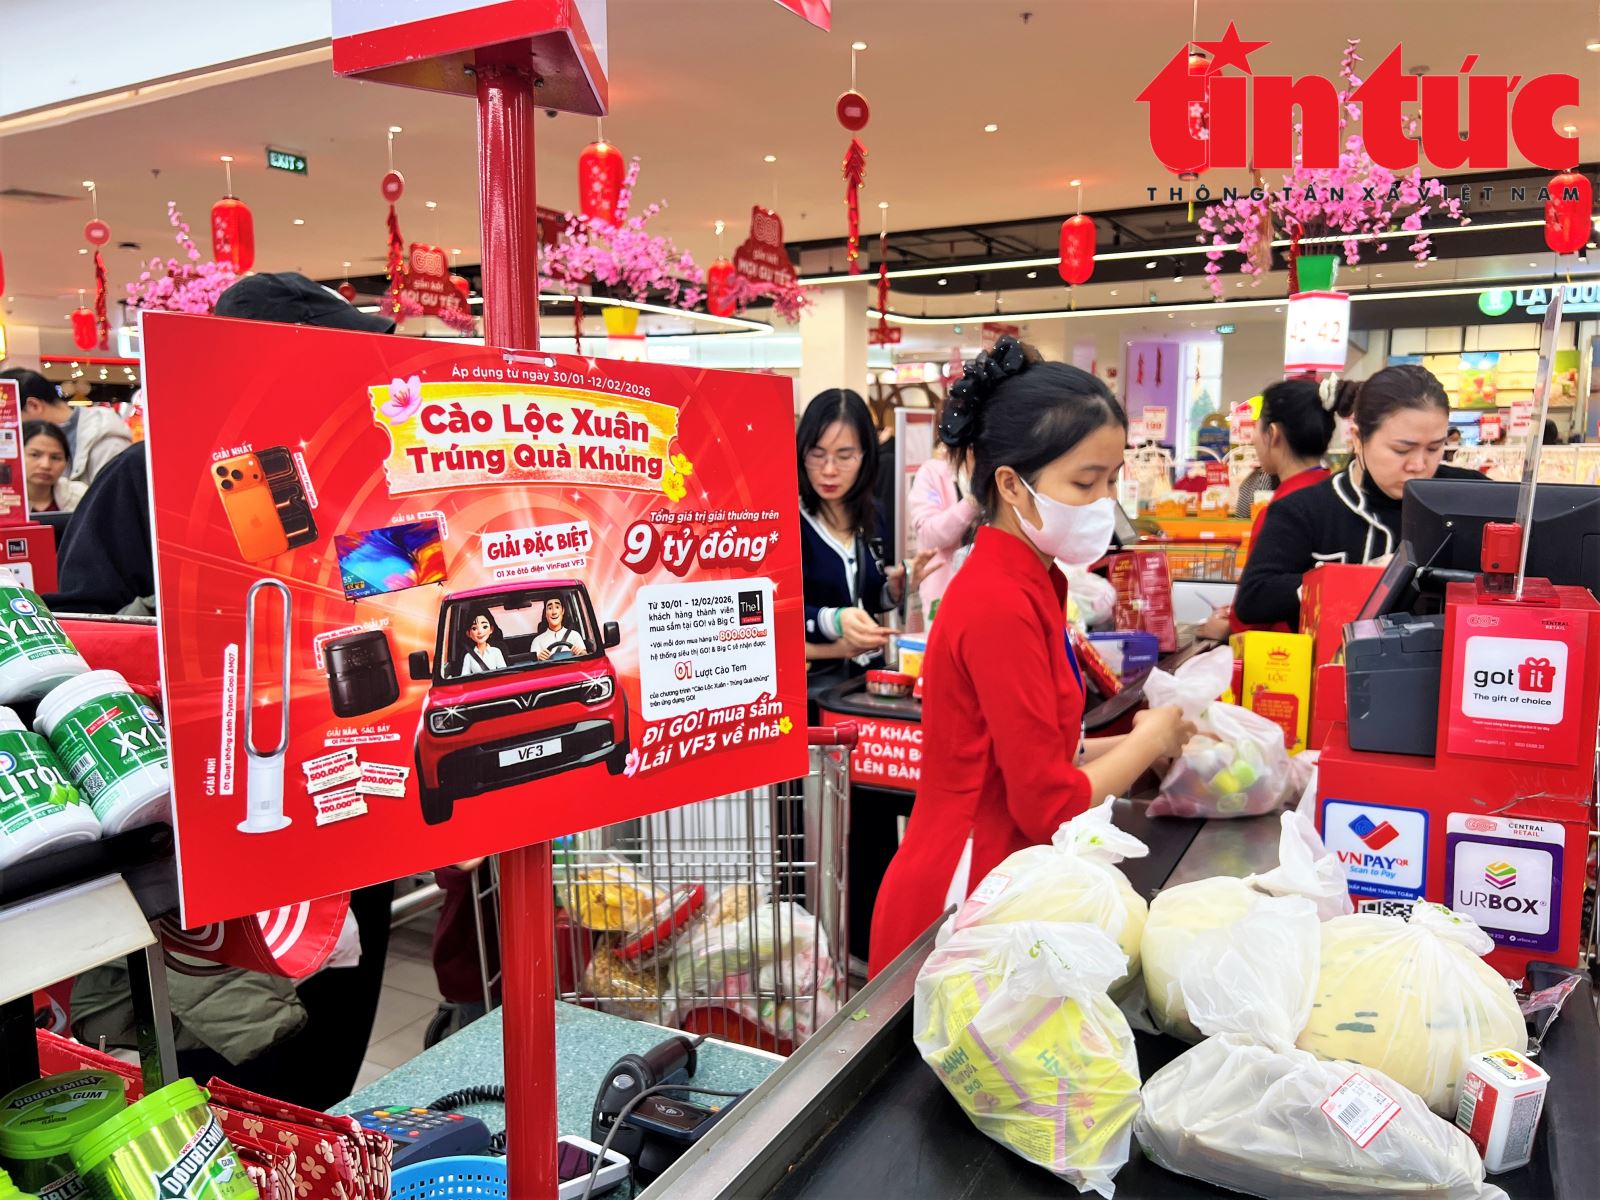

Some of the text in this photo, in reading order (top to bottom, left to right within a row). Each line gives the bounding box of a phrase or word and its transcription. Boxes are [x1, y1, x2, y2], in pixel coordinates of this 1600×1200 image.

[270, 151, 296, 170] EXIT
[451, 365, 651, 398] Áp dụng từ ngày 30/01 -12/02/2026
[420, 401, 649, 443] Cào Lộc Xuân
[231, 440, 253, 457] NHẤT
[406, 442, 663, 480] Trúng Quà Khủng
[650, 508, 779, 524] Tổng giá trị giải thưởng trên
[487, 525, 589, 561] GIẢI ĐẶC BIỆT
[624, 523, 653, 564] 9
[663, 527, 694, 567] tỷ
[506, 569, 516, 577] Xe
[530, 565, 545, 574] điện
[546, 561, 570, 571] VinFast
[571, 558, 585, 567] VF3
[648, 601, 658, 610] Từ
[661, 600, 682, 609] 30/01
[648, 606, 735, 622] khách hàng thành viên
[649, 616, 735, 633] mua sắm tại GO! và Big C
[716, 645, 726, 654] Big
[674, 660, 747, 681] 01 Lượt Cào Tem
[1474, 669, 1544, 688] got it
[226, 694, 235, 717] Dyson
[1472, 693, 1490, 701] The
[1491, 694, 1507, 703] gift
[1521, 698, 1552, 706] choice
[225, 718, 233, 737] cánh
[642, 693, 783, 748] Đi GO! mua sắm
[880, 726, 923, 744] KHÁC
[223, 737, 233, 761] không
[639, 720, 781, 772] Lái VF3 về nhà
[862, 741, 905, 760] TOÀN
[855, 758, 884, 775] LÊN
[1508, 822, 1545, 832] CENTRAL
[1513, 829, 1540, 837] RETAIL
[1350, 865, 1397, 880] Scan to Pay
[1377, 887, 1398, 896] THANH
[1397, 889, 1414, 898] TOÁN
[14, 1076, 98, 1107] DOUBLEMINT
[73, 1091, 103, 1100] GUM
